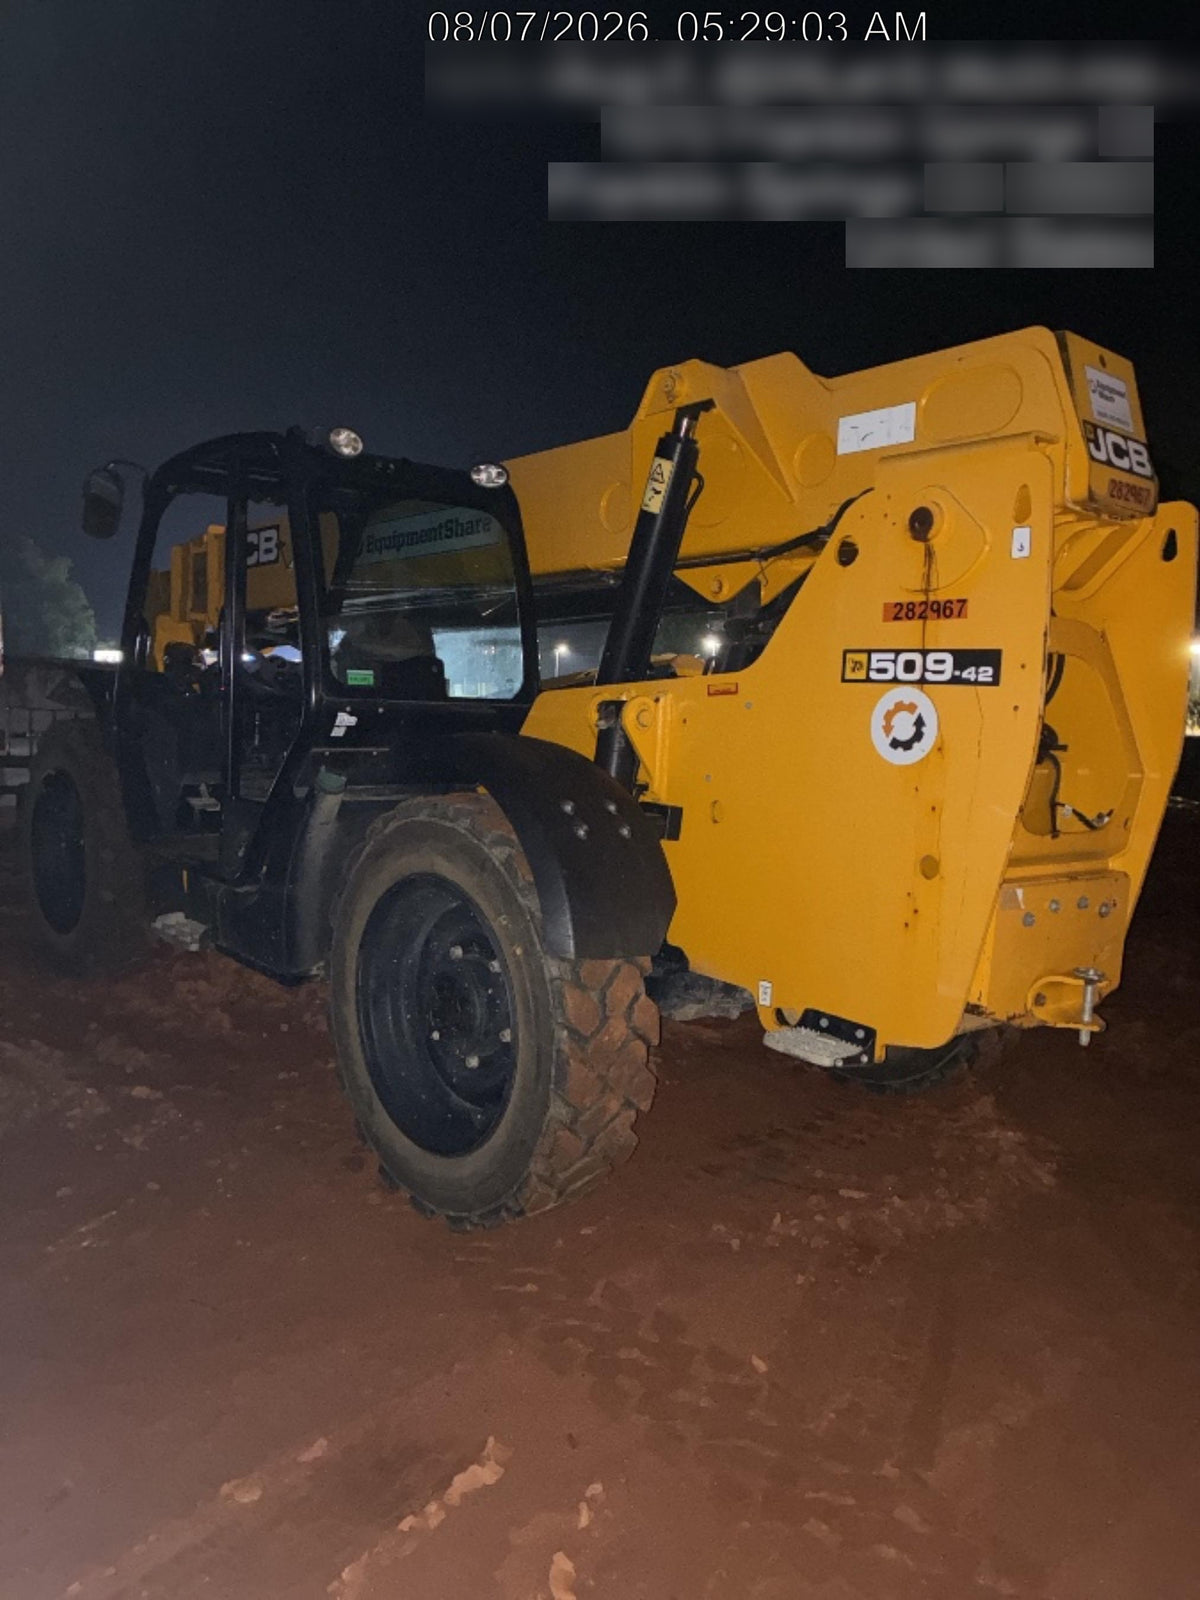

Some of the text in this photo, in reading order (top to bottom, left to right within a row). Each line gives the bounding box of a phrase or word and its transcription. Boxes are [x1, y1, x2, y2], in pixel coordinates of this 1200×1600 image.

[1089, 427, 1154, 478] JCB
[247, 529, 278, 566] CB
[365, 517, 492, 555] EquipmentShare
[892, 598, 968, 621] 282967
[868, 651, 994, 682] 509-42
